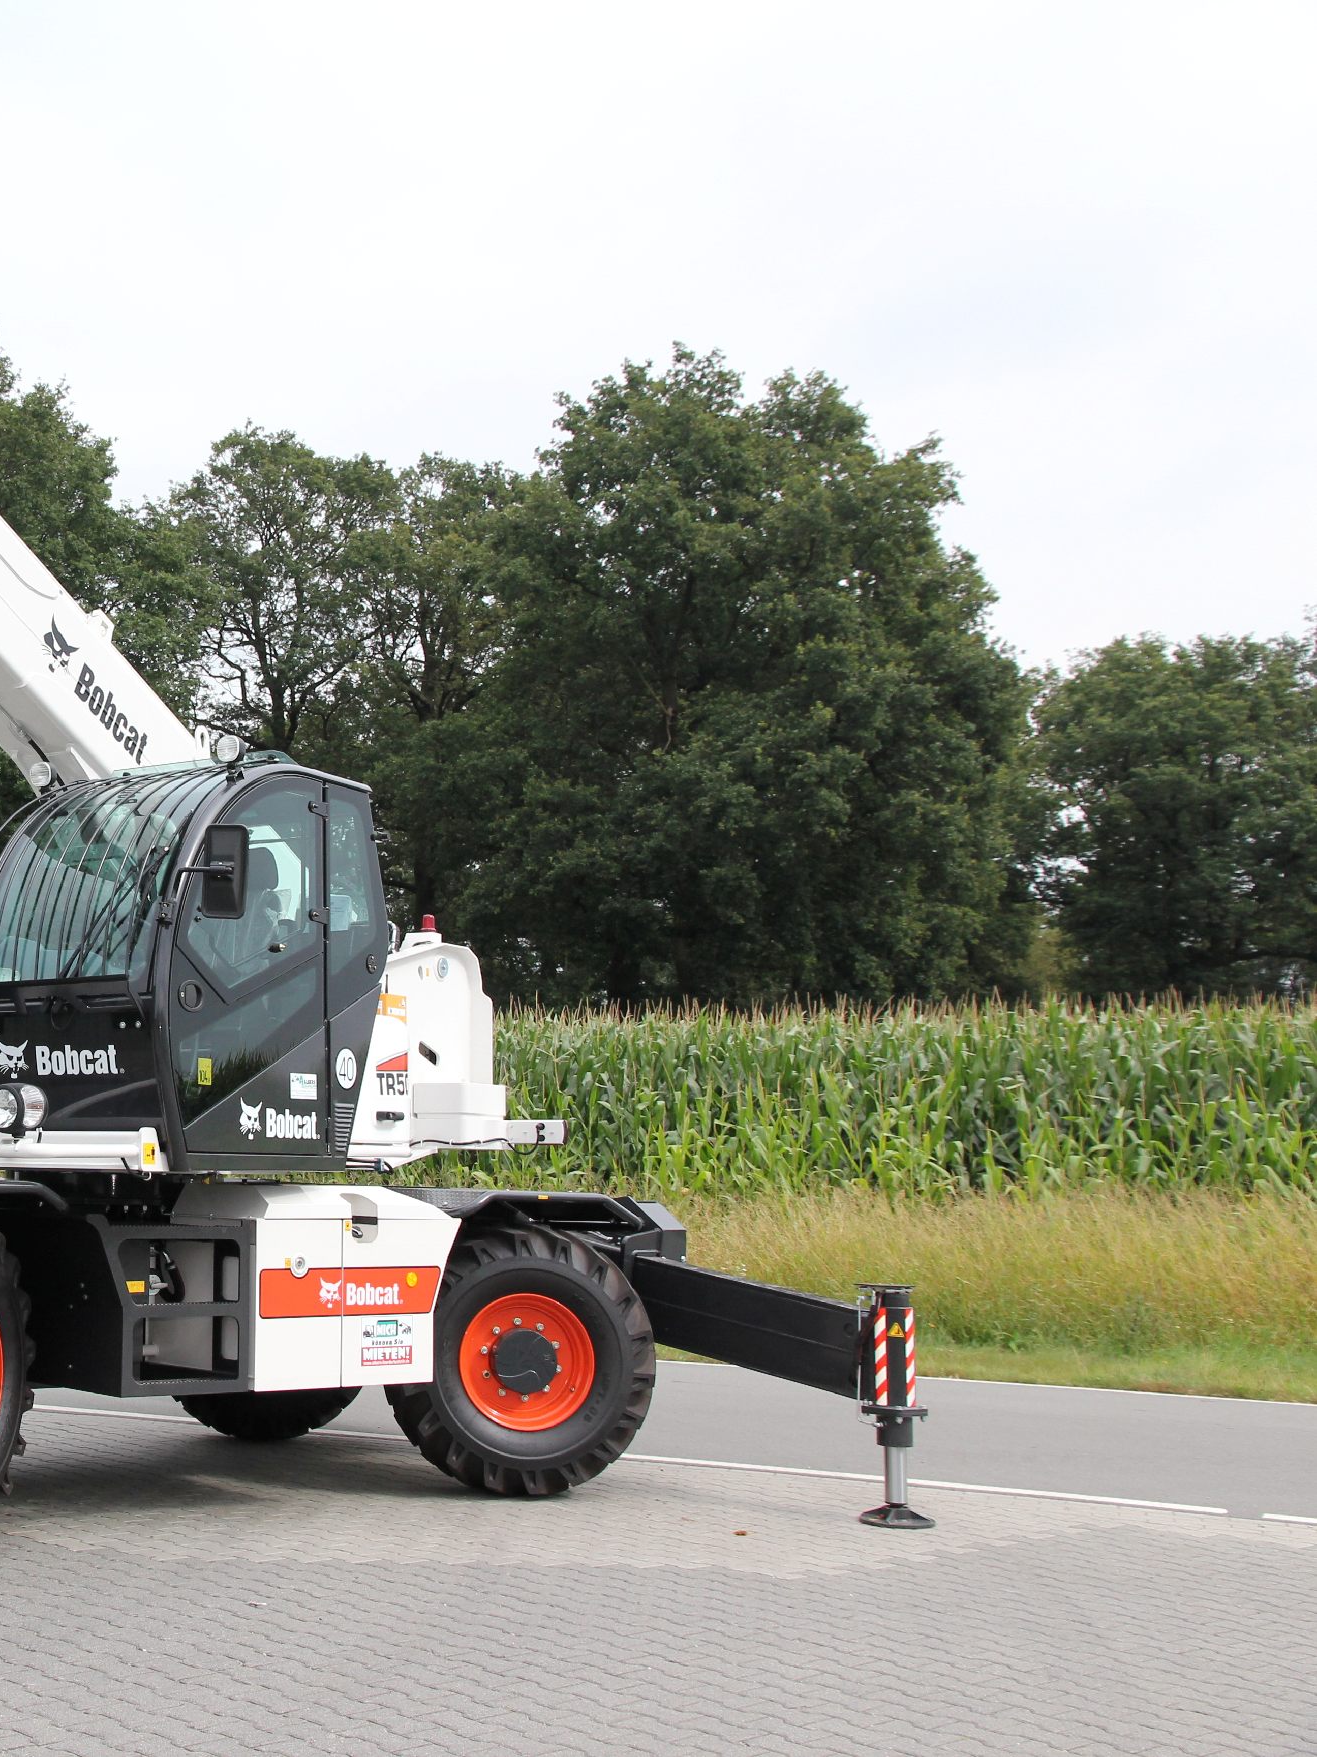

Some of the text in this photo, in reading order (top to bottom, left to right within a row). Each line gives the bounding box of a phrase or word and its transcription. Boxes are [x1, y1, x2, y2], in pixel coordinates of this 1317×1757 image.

[74, 662, 148, 765] Bobcat
[35, 1044, 118, 1076] Bobcat
[338, 1056, 355, 1082] 40
[265, 1107, 317, 1139] Bobcat
[346, 1282, 399, 1306] Bobcat
[362, 1346, 411, 1361] MIETEN!
